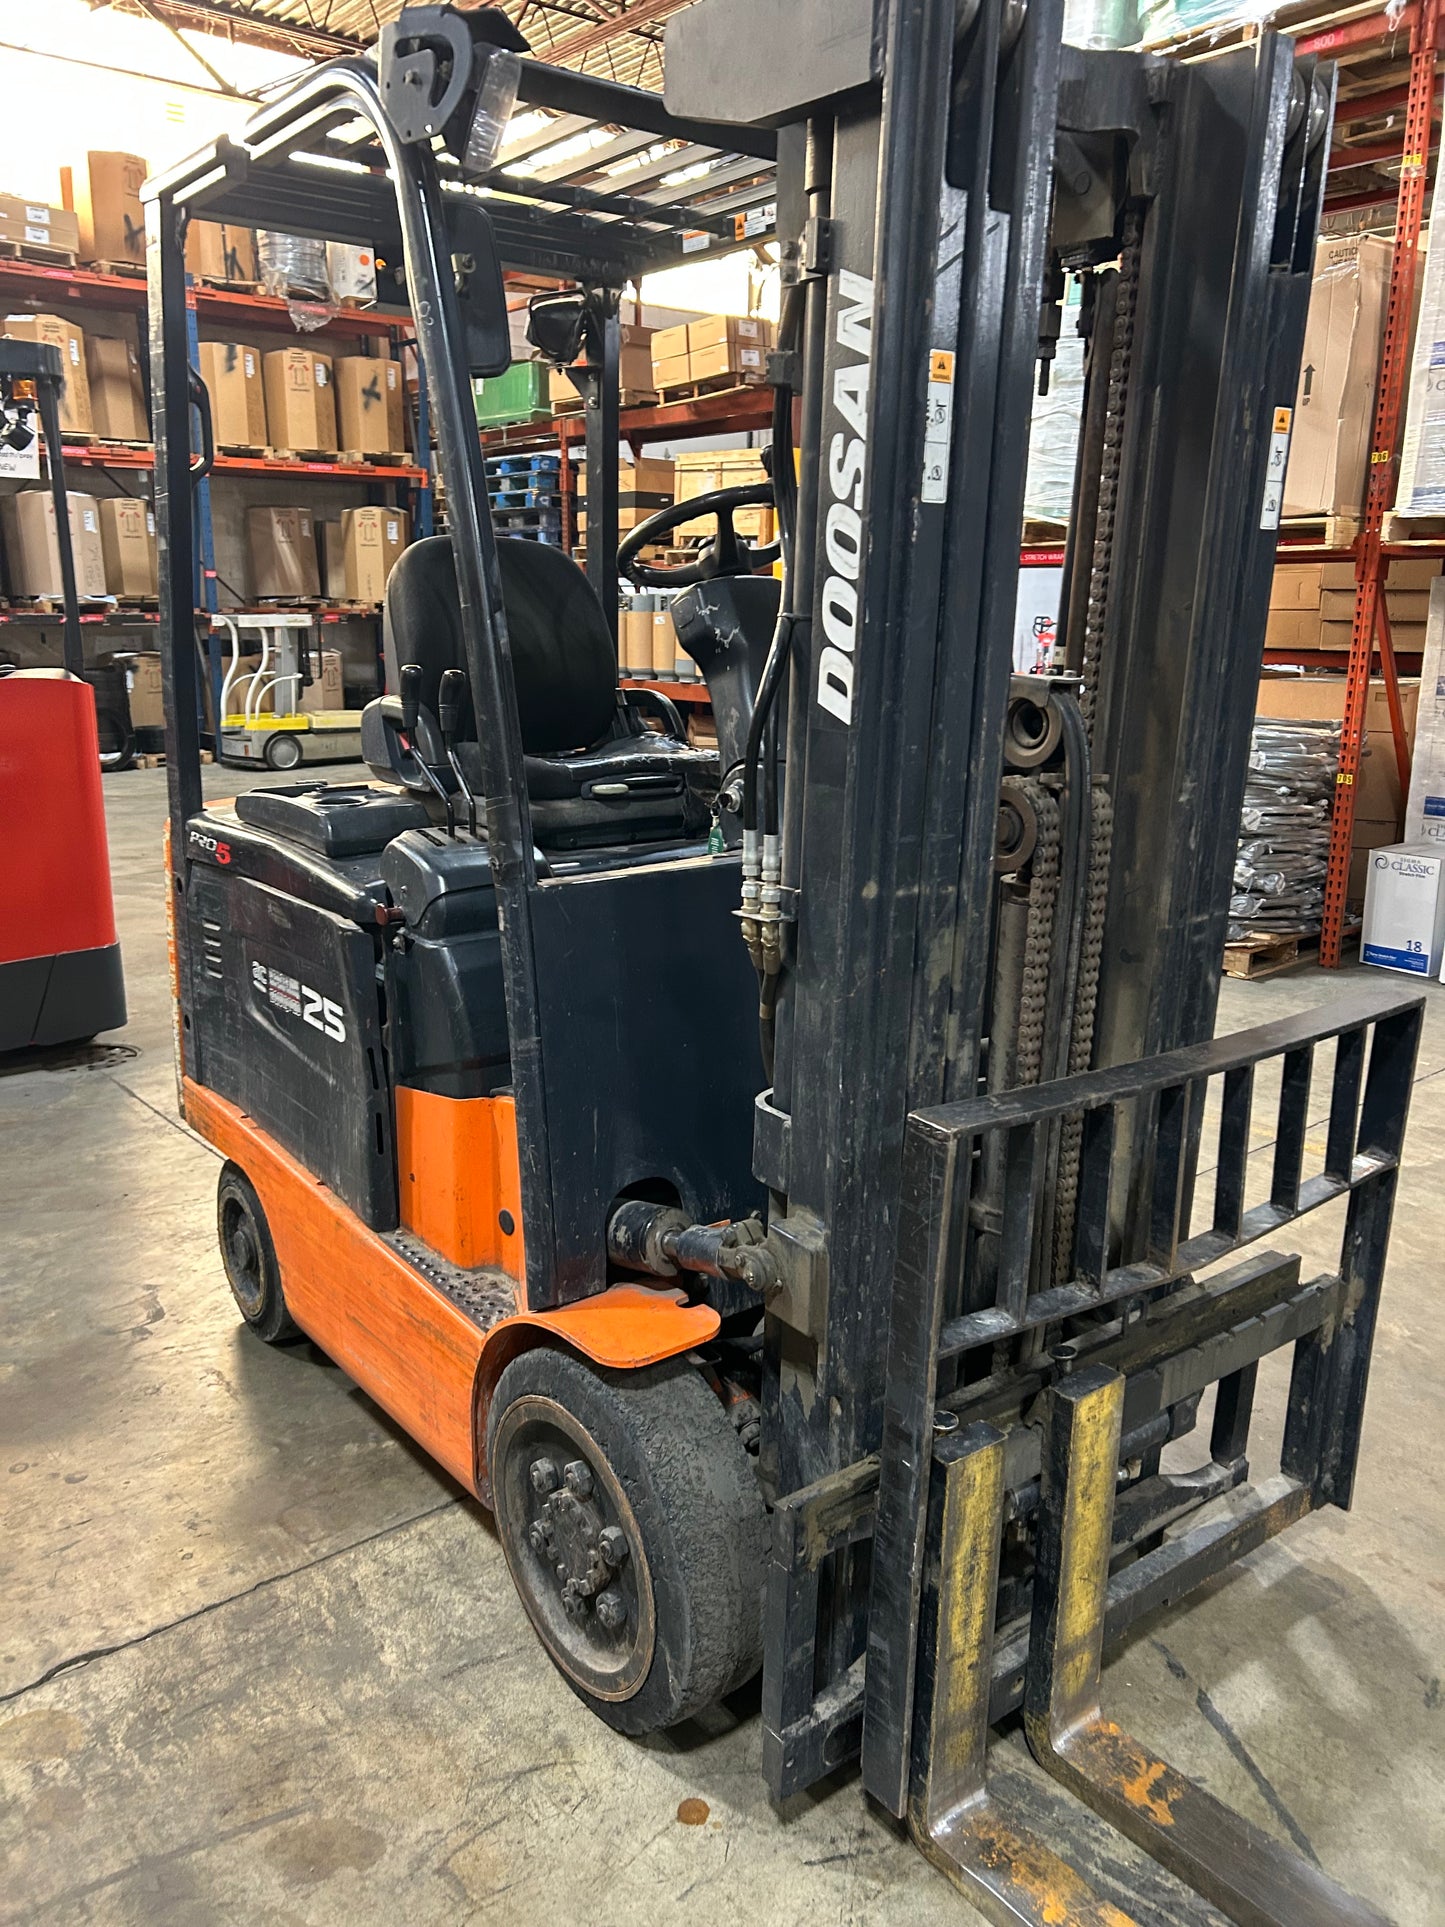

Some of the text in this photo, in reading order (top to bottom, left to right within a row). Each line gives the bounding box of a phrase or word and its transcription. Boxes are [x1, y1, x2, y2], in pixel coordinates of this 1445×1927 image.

[1313, 33, 1335, 49] 800
[1328, 246, 1358, 259] CAUTIO
[1372, 453, 1387, 462] 706
[817, 269, 874, 725] DOOSAN
[1337, 775, 1352, 783] 705
[1391, 861, 1434, 875] CLASSIC
[1405, 940, 1423, 952] 18
[301, 984, 347, 1043] 25
